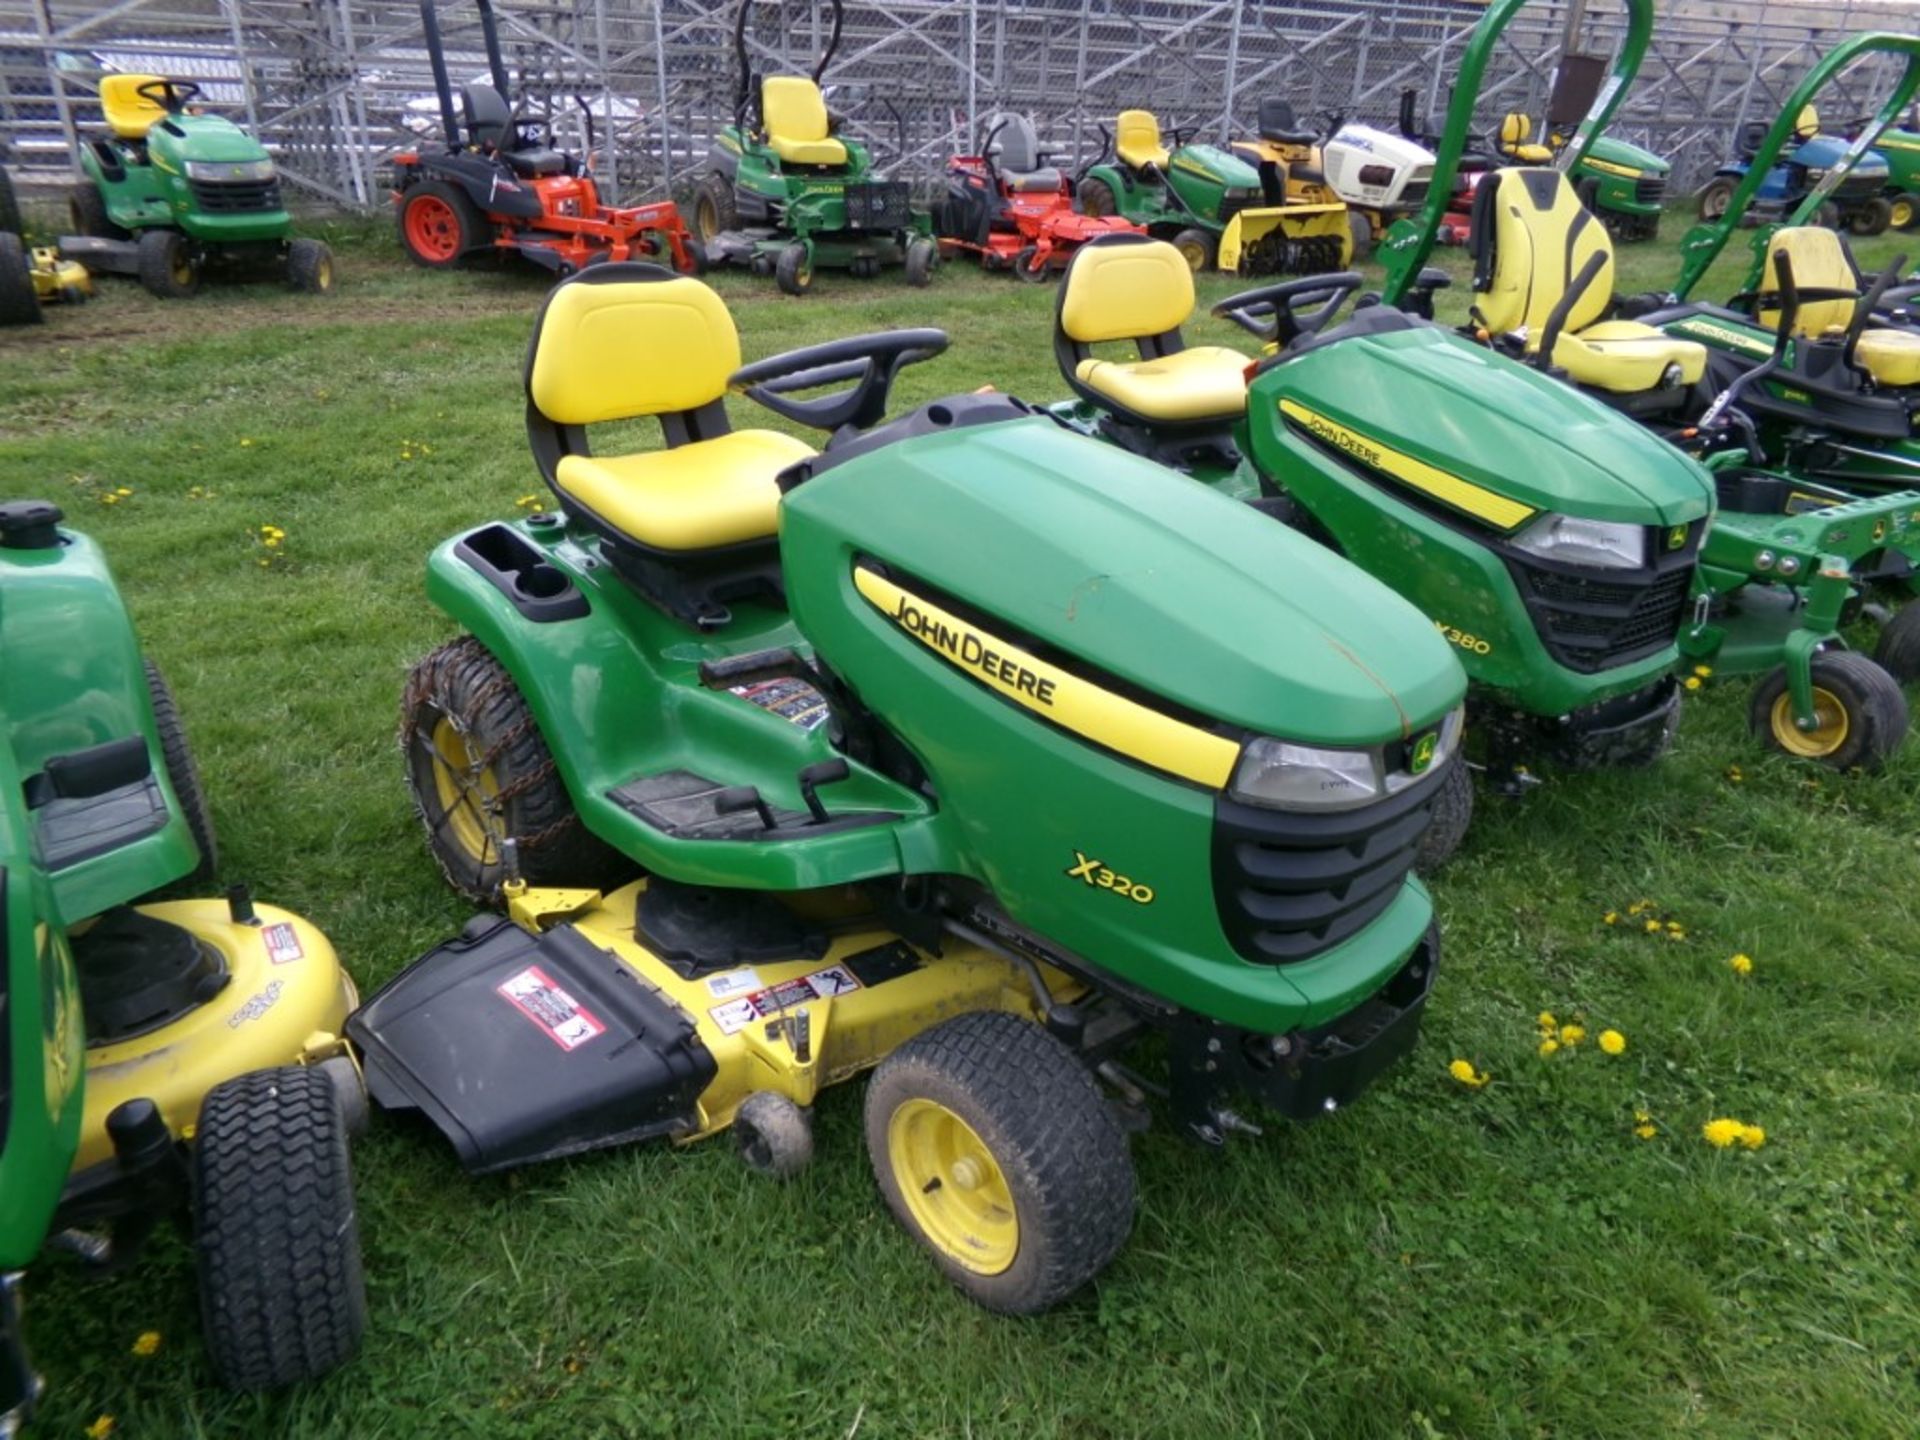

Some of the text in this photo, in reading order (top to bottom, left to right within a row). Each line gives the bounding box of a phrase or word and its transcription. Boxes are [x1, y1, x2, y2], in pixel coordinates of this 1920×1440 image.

[1309, 414, 1381, 466] JOHN DEERE
[890, 597, 1056, 706] JOHN DEERE
[1066, 851, 1153, 903] X320
